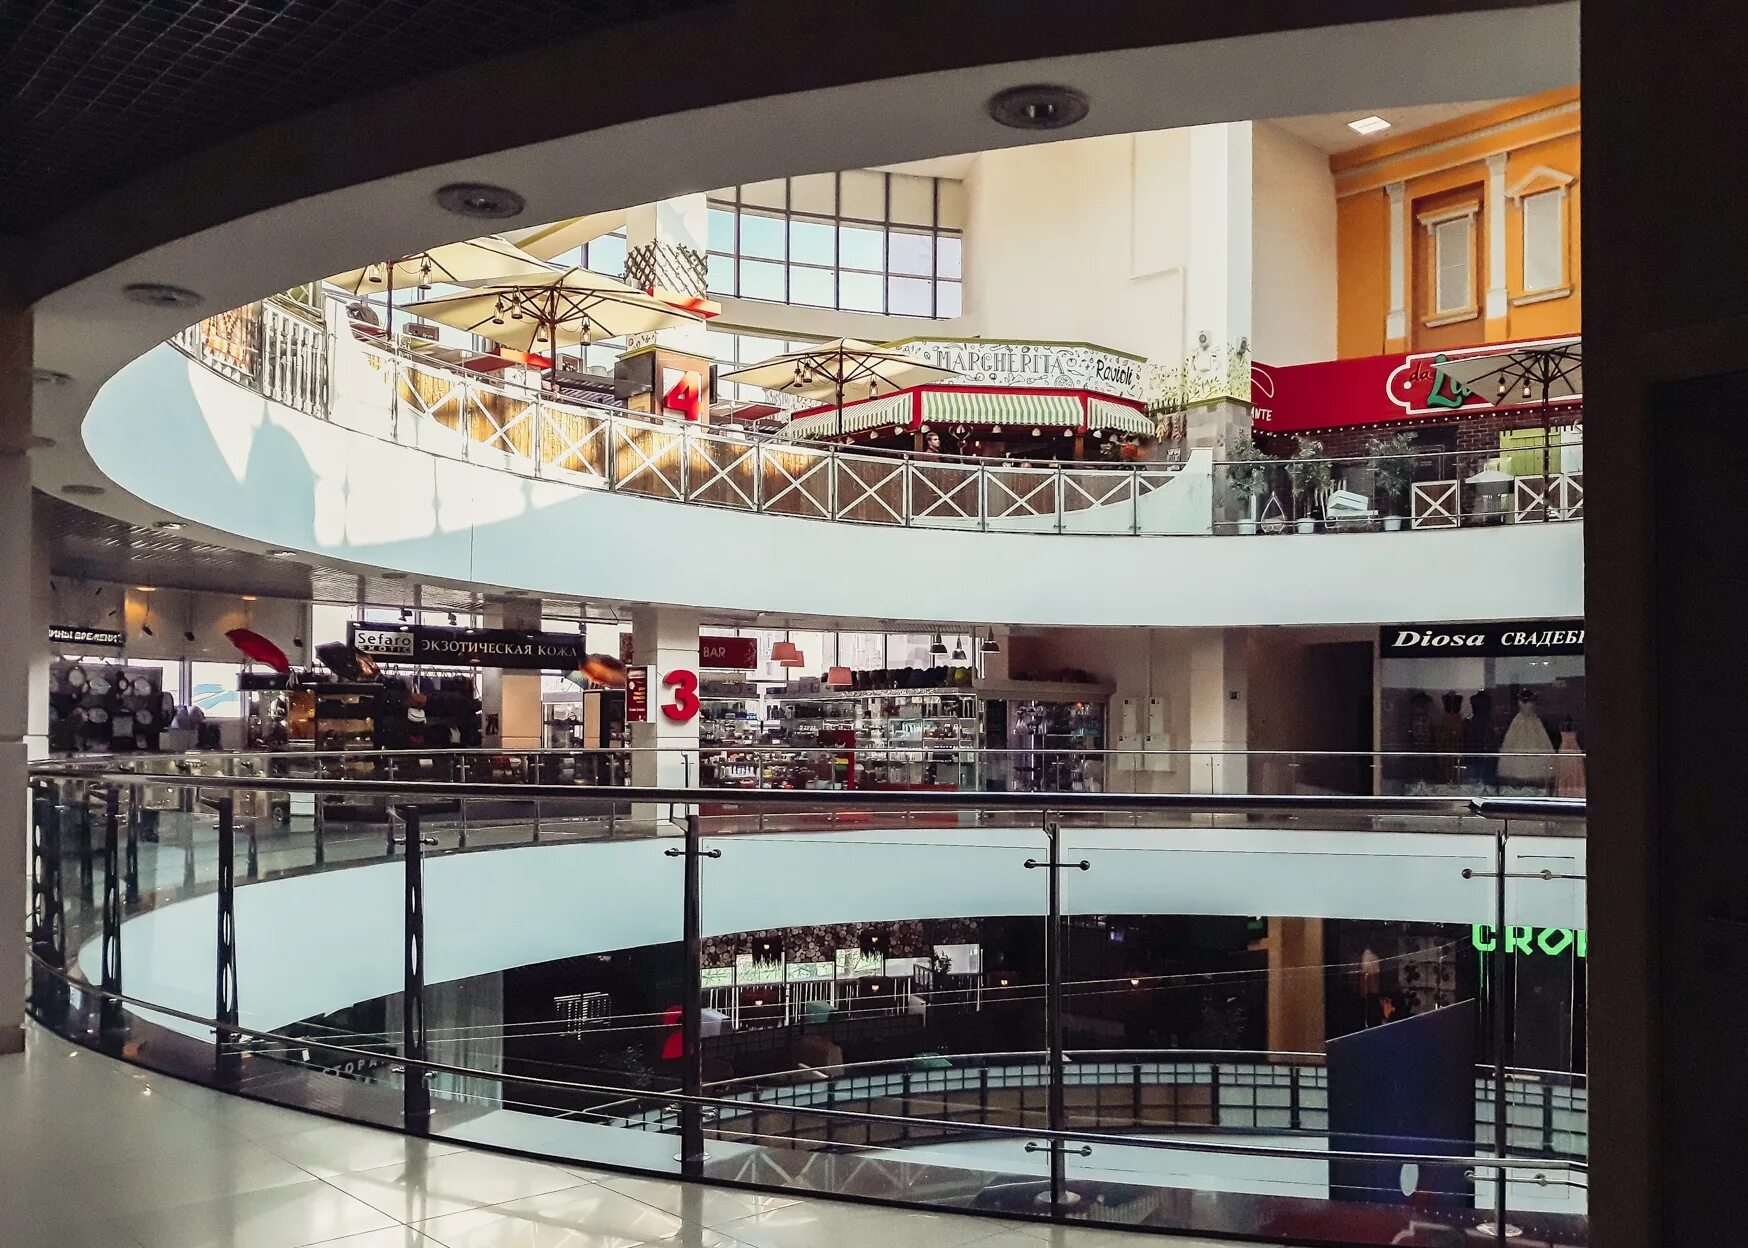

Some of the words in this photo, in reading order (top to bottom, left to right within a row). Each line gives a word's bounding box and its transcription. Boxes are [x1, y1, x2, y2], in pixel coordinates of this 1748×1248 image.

[936, 350, 1065, 375] MARGHERITA
[1096, 359, 1134, 386] Ravioli
[1409, 360, 1435, 382] da
[663, 370, 700, 422] 4
[358, 632, 411, 646] Sefaro
[421, 639, 533, 655] ЭКЗОТИЧЕСКАЯ
[538, 645, 577, 657] КОЖА
[1391, 630, 1486, 648] Diosa
[703, 646, 726, 658] BAR
[661, 669, 699, 721] 3
